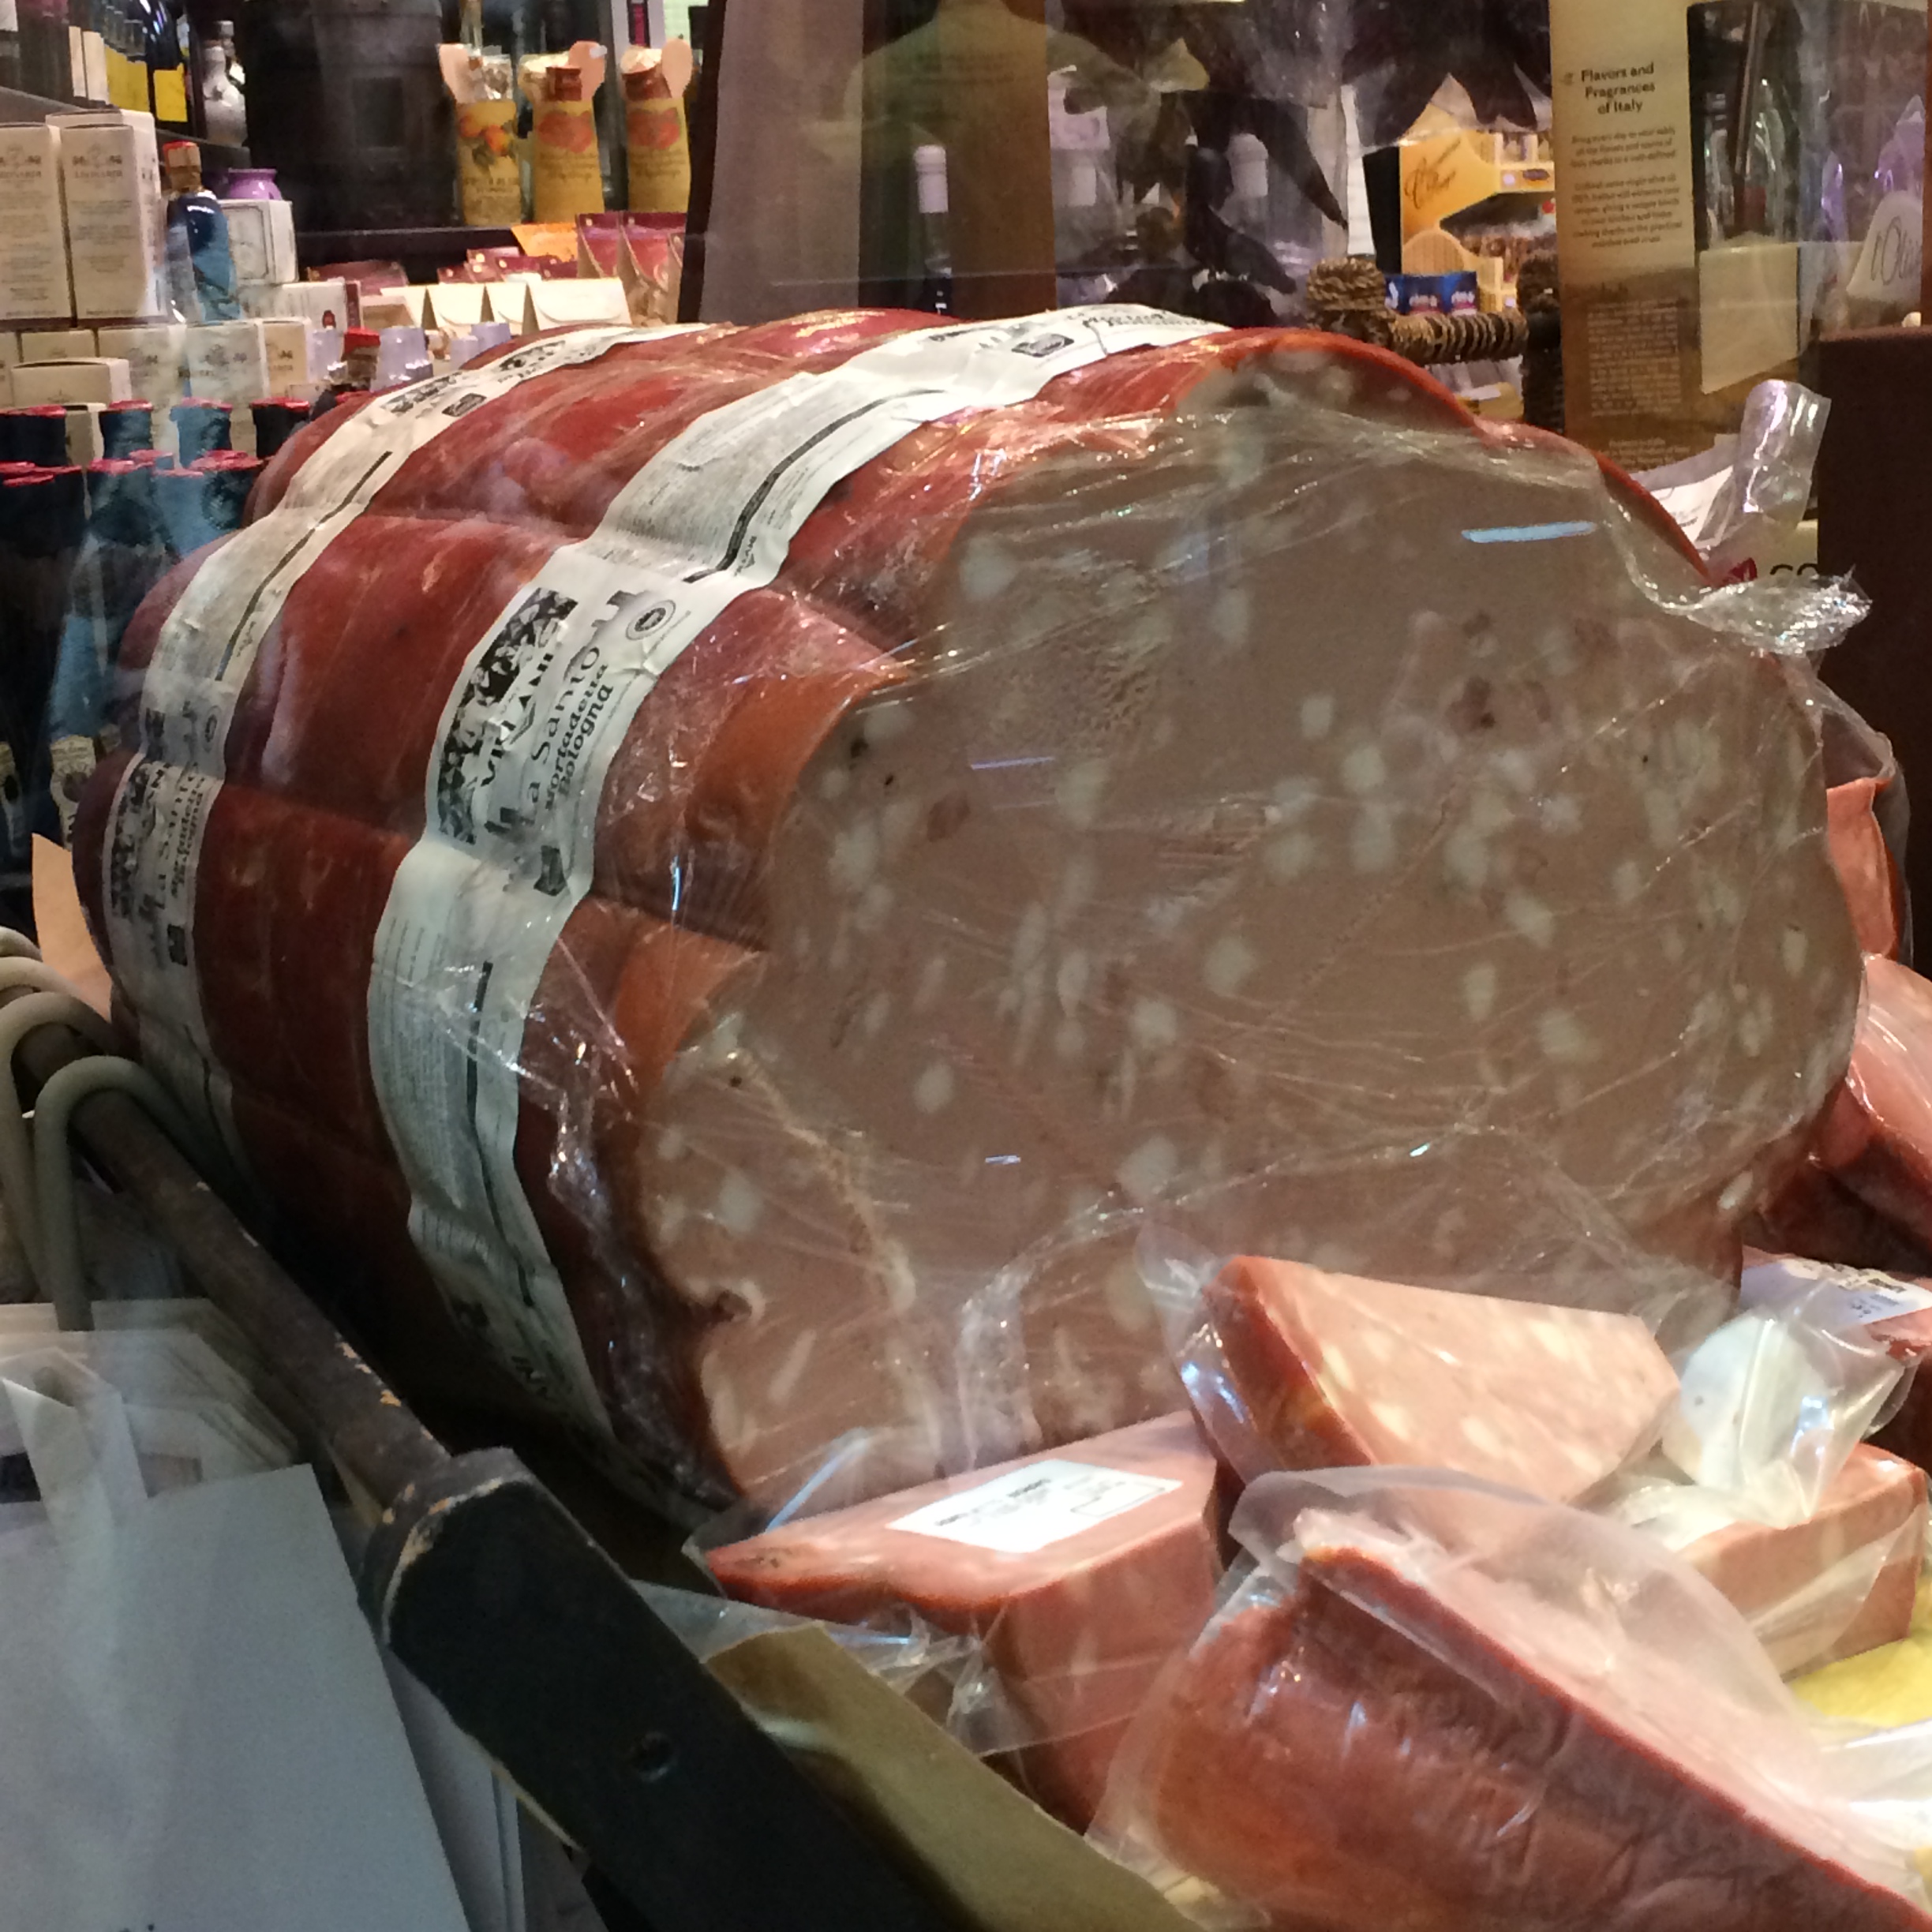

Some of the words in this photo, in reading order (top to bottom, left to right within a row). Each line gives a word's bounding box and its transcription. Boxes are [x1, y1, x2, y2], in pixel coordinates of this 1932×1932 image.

[1581, 68, 1627, 82] Flavors
[1631, 62, 1654, 77] and
[1585, 82, 1656, 100] Fragrances
[1597, 102, 1610, 114] of
[1614, 99, 1643, 113] Italy
[556, 683, 612, 794] Bologna
